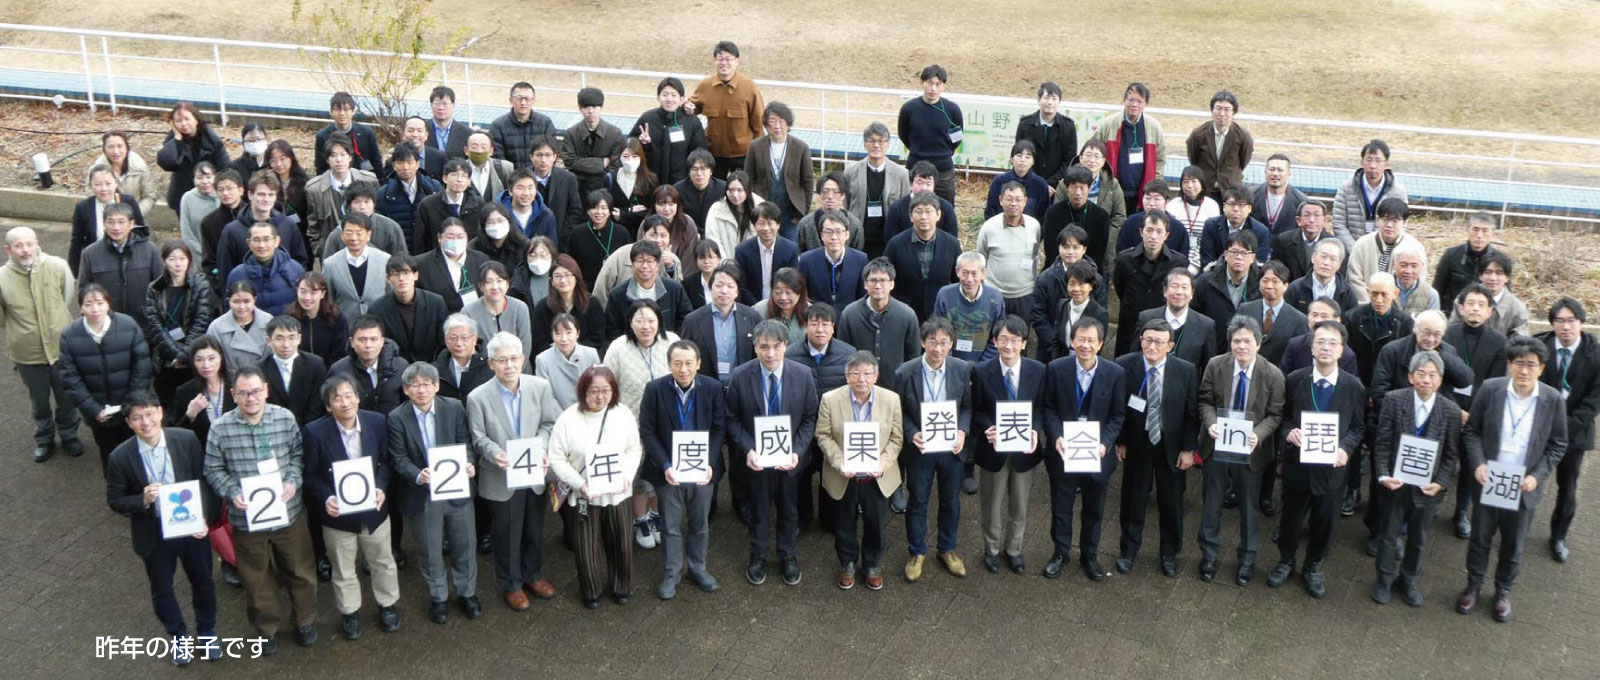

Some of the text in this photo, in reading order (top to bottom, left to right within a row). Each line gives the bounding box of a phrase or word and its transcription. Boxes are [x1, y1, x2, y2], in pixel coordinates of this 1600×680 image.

[968, 109, 1025, 130] 山野
[759, 425, 791, 456] 成
[925, 411, 956, 442] 発
[999, 411, 1030, 442] 表
[1222, 422, 1247, 448] in
[1303, 422, 1337, 454] 琵
[512, 447, 538, 475] 4
[675, 440, 708, 472] 度
[847, 432, 879, 463] 果
[1066, 431, 1098, 461] 会
[1400, 444, 1434, 478] 琶
[433, 458, 464, 494] 2
[588, 449, 623, 481] 年
[337, 470, 370, 506] 0
[1485, 469, 1522, 502] 湖
[248, 487, 282, 525] 2
